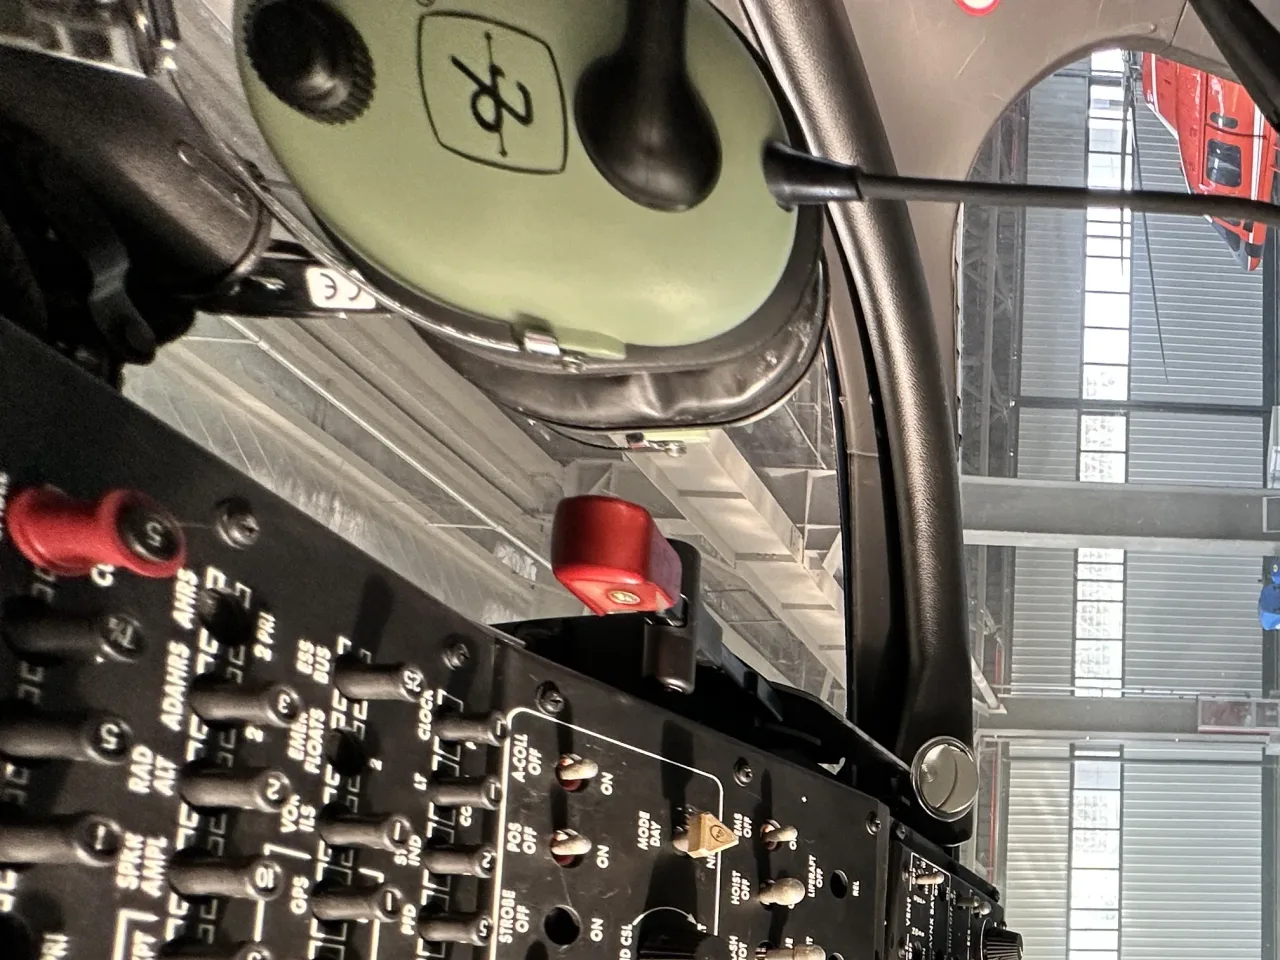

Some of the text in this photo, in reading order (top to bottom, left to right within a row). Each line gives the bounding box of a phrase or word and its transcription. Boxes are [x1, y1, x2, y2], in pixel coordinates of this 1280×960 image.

[172, 566, 198, 628] AHRS
[258, 610, 276, 644] PRI
[297, 639, 314, 674] ESS
[313, 646, 330, 684] BUS
[161, 640, 190, 732] ADAHRS
[304, 707, 326, 774] FLOATS
[128, 745, 154, 793] RAD
[513, 734, 528, 783] A-COLL
[528, 747, 542, 776] OFF
[152, 754, 176, 796] ALT
[414, 772, 427, 790] LT
[600, 772, 614, 796] ON
[300, 803, 316, 832] ILS
[638, 810, 650, 850] MODE
[650, 821, 661, 846] DAY
[734, 813, 743, 836] EMS
[743, 816, 752, 838] OFF
[408, 835, 422, 866] IND
[506, 822, 522, 853] POS
[522, 826, 538, 854] OFF
[140, 836, 168, 897] AMPL
[596, 845, 610, 869] ON
[731, 870, 741, 904] HOIST
[741, 878, 750, 900] OFF
[808, 854, 816, 897] LIFERAFT
[852, 881, 860, 896] REL
[290, 876, 308, 915] GPS
[402, 902, 417, 936] PFD
[498, 889, 515, 944] STROBE
[515, 905, 530, 933] OFF
[590, 918, 603, 942] ON
[620, 924, 632, 946] CSL
